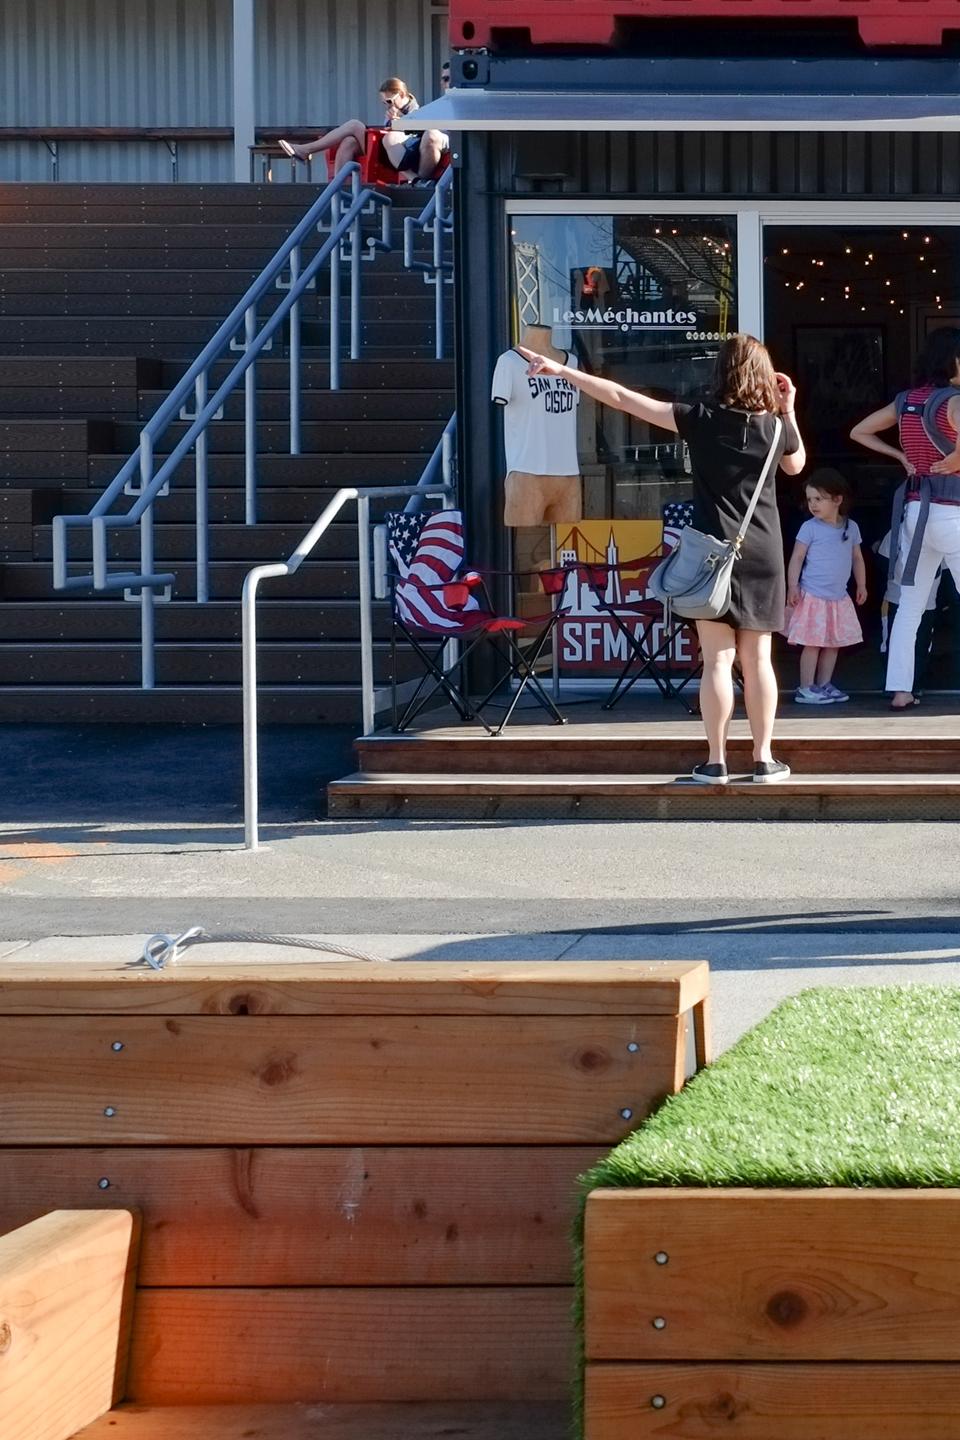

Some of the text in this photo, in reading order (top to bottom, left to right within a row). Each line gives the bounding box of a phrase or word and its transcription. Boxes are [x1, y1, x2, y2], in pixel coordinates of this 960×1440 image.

[552, 307, 697, 324] LesMéchantes
[528, 377, 551, 399] SAN
[545, 390, 573, 413] CISCO
[562, 622, 692, 662] SFMADE
